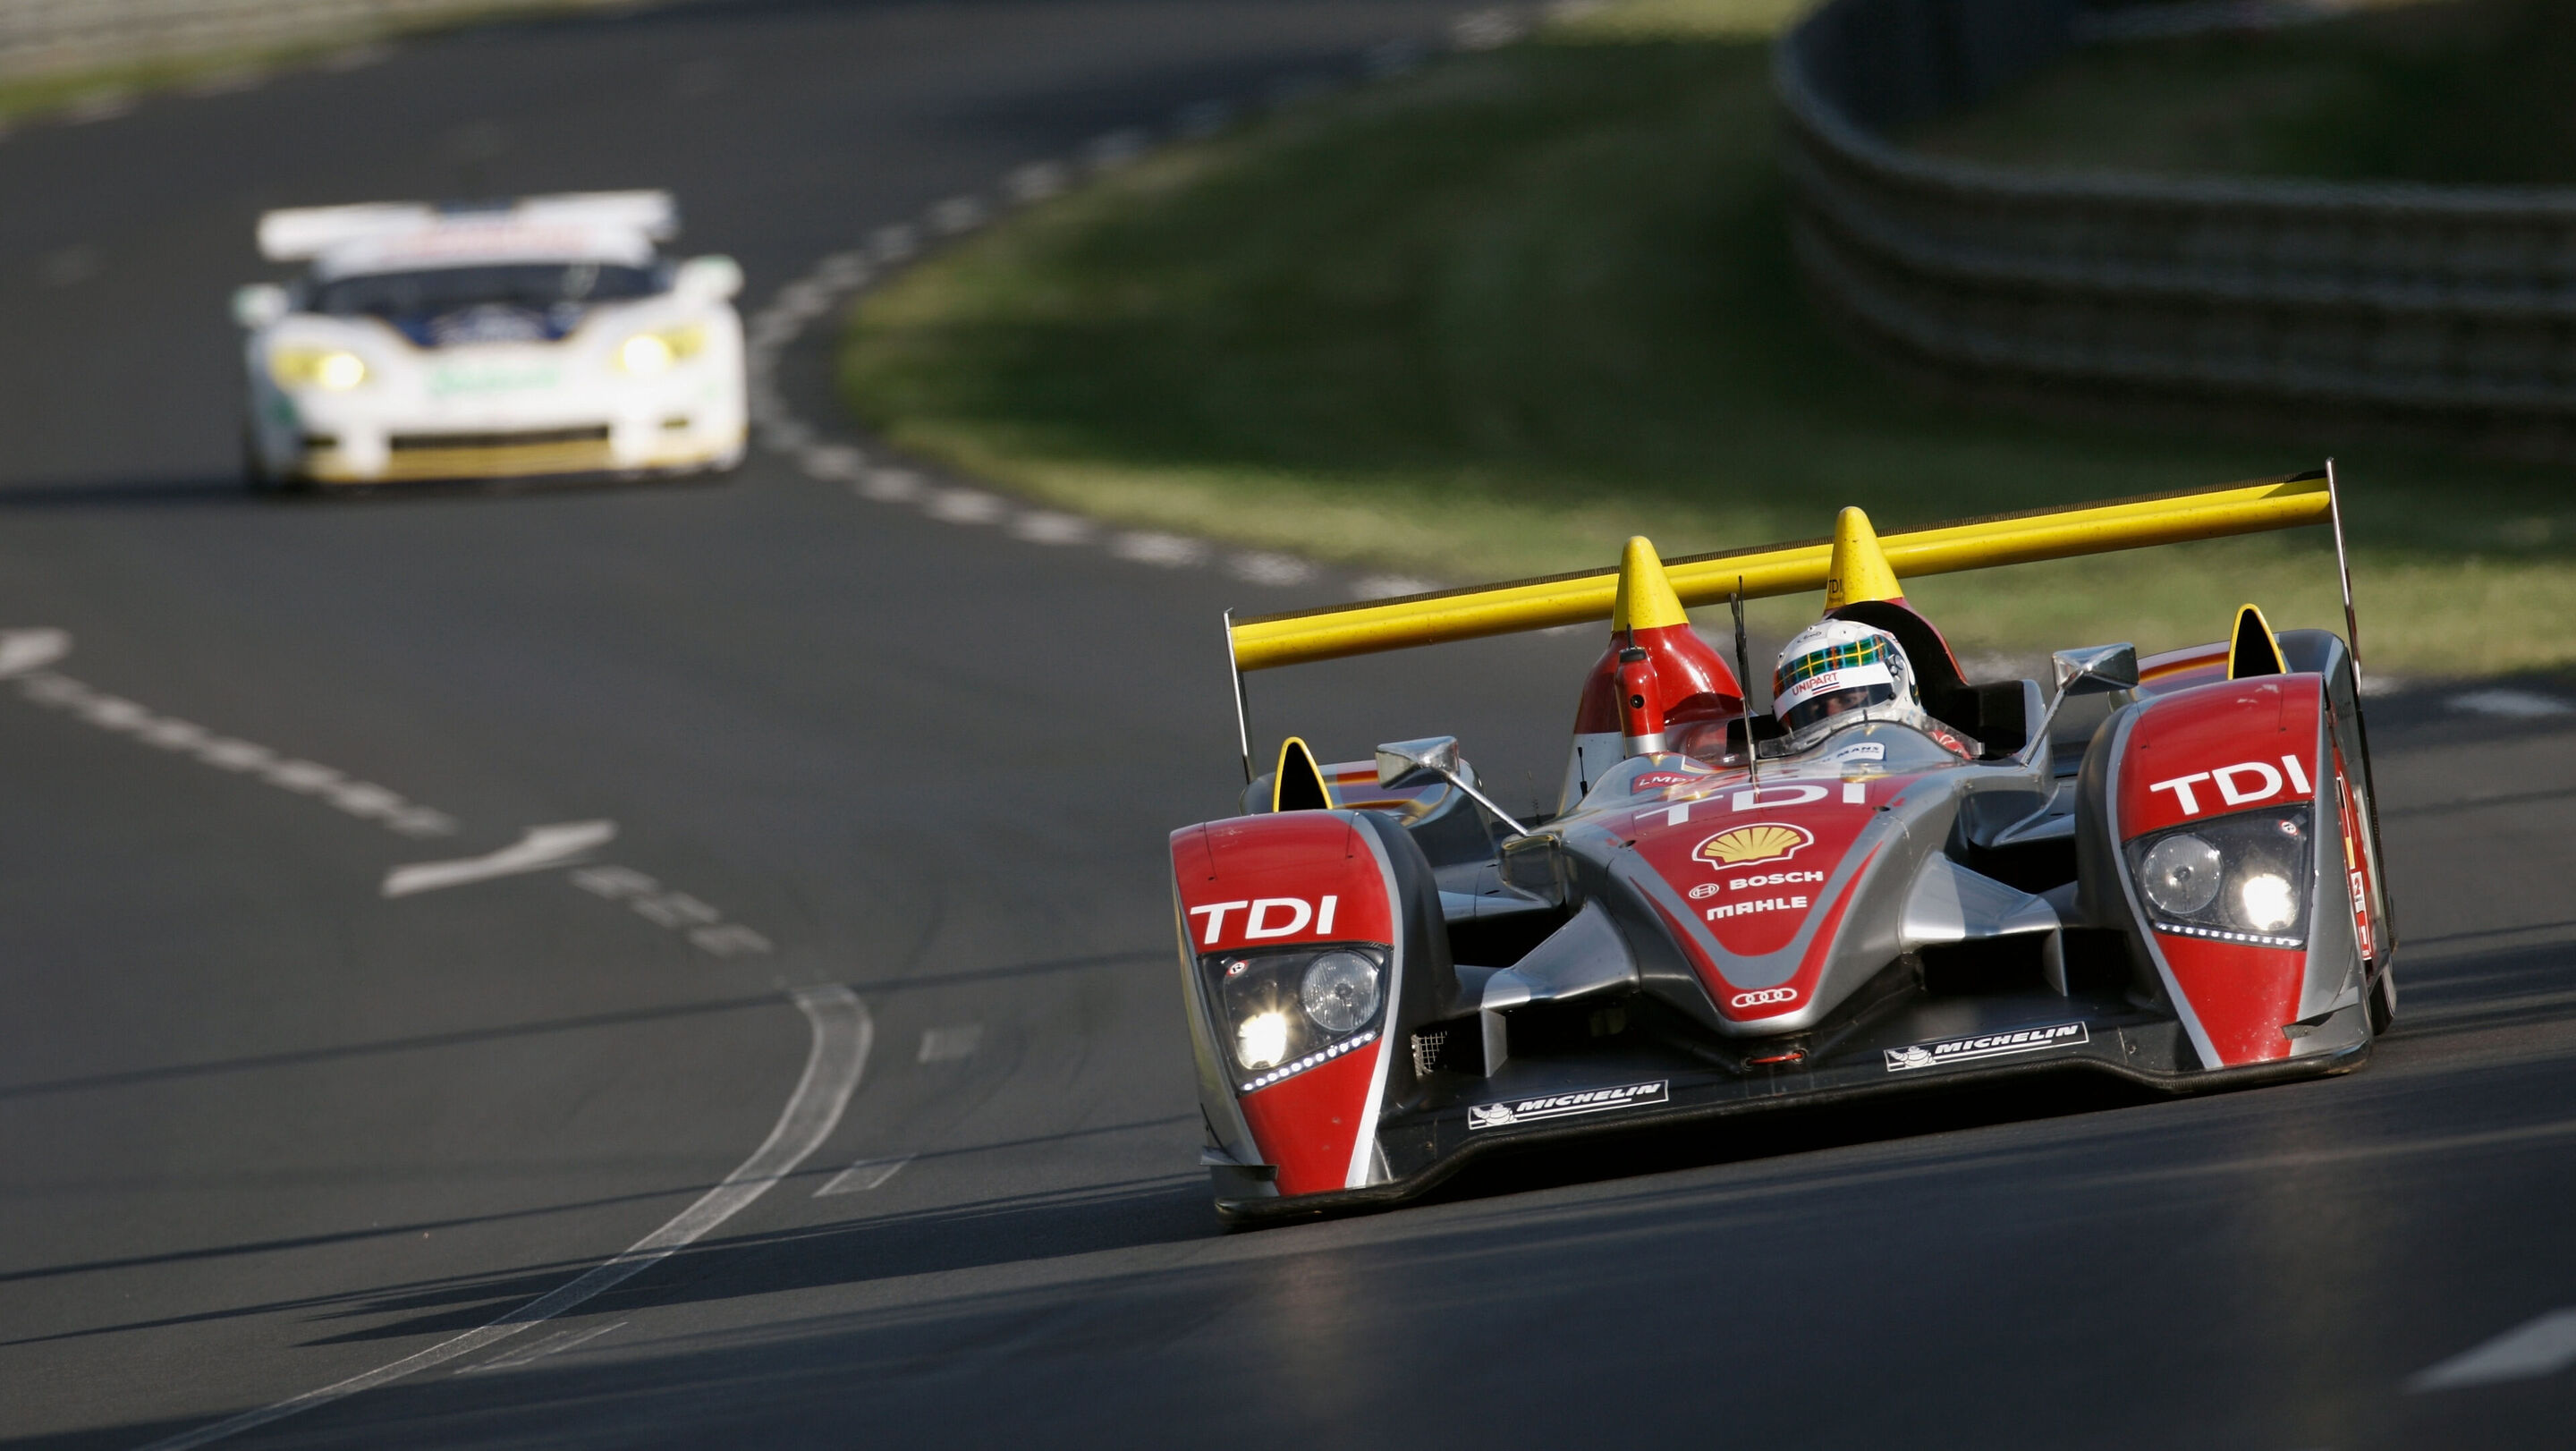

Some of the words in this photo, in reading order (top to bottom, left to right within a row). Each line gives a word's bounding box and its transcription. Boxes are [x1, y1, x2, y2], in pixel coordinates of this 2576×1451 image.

[1792, 672, 1838, 696] UNIPART
[1639, 776, 1696, 787] LMP
[2149, 754, 2311, 816] TDI
[1635, 784, 1866, 827] TDI
[1729, 870, 1824, 891] BOSCH
[1190, 895, 1338, 945] TDI
[1707, 895, 1808, 921] MAHLE
[1934, 1024, 2079, 1055] MICHELIN
[1516, 1082, 1661, 1112] MICHELIN
